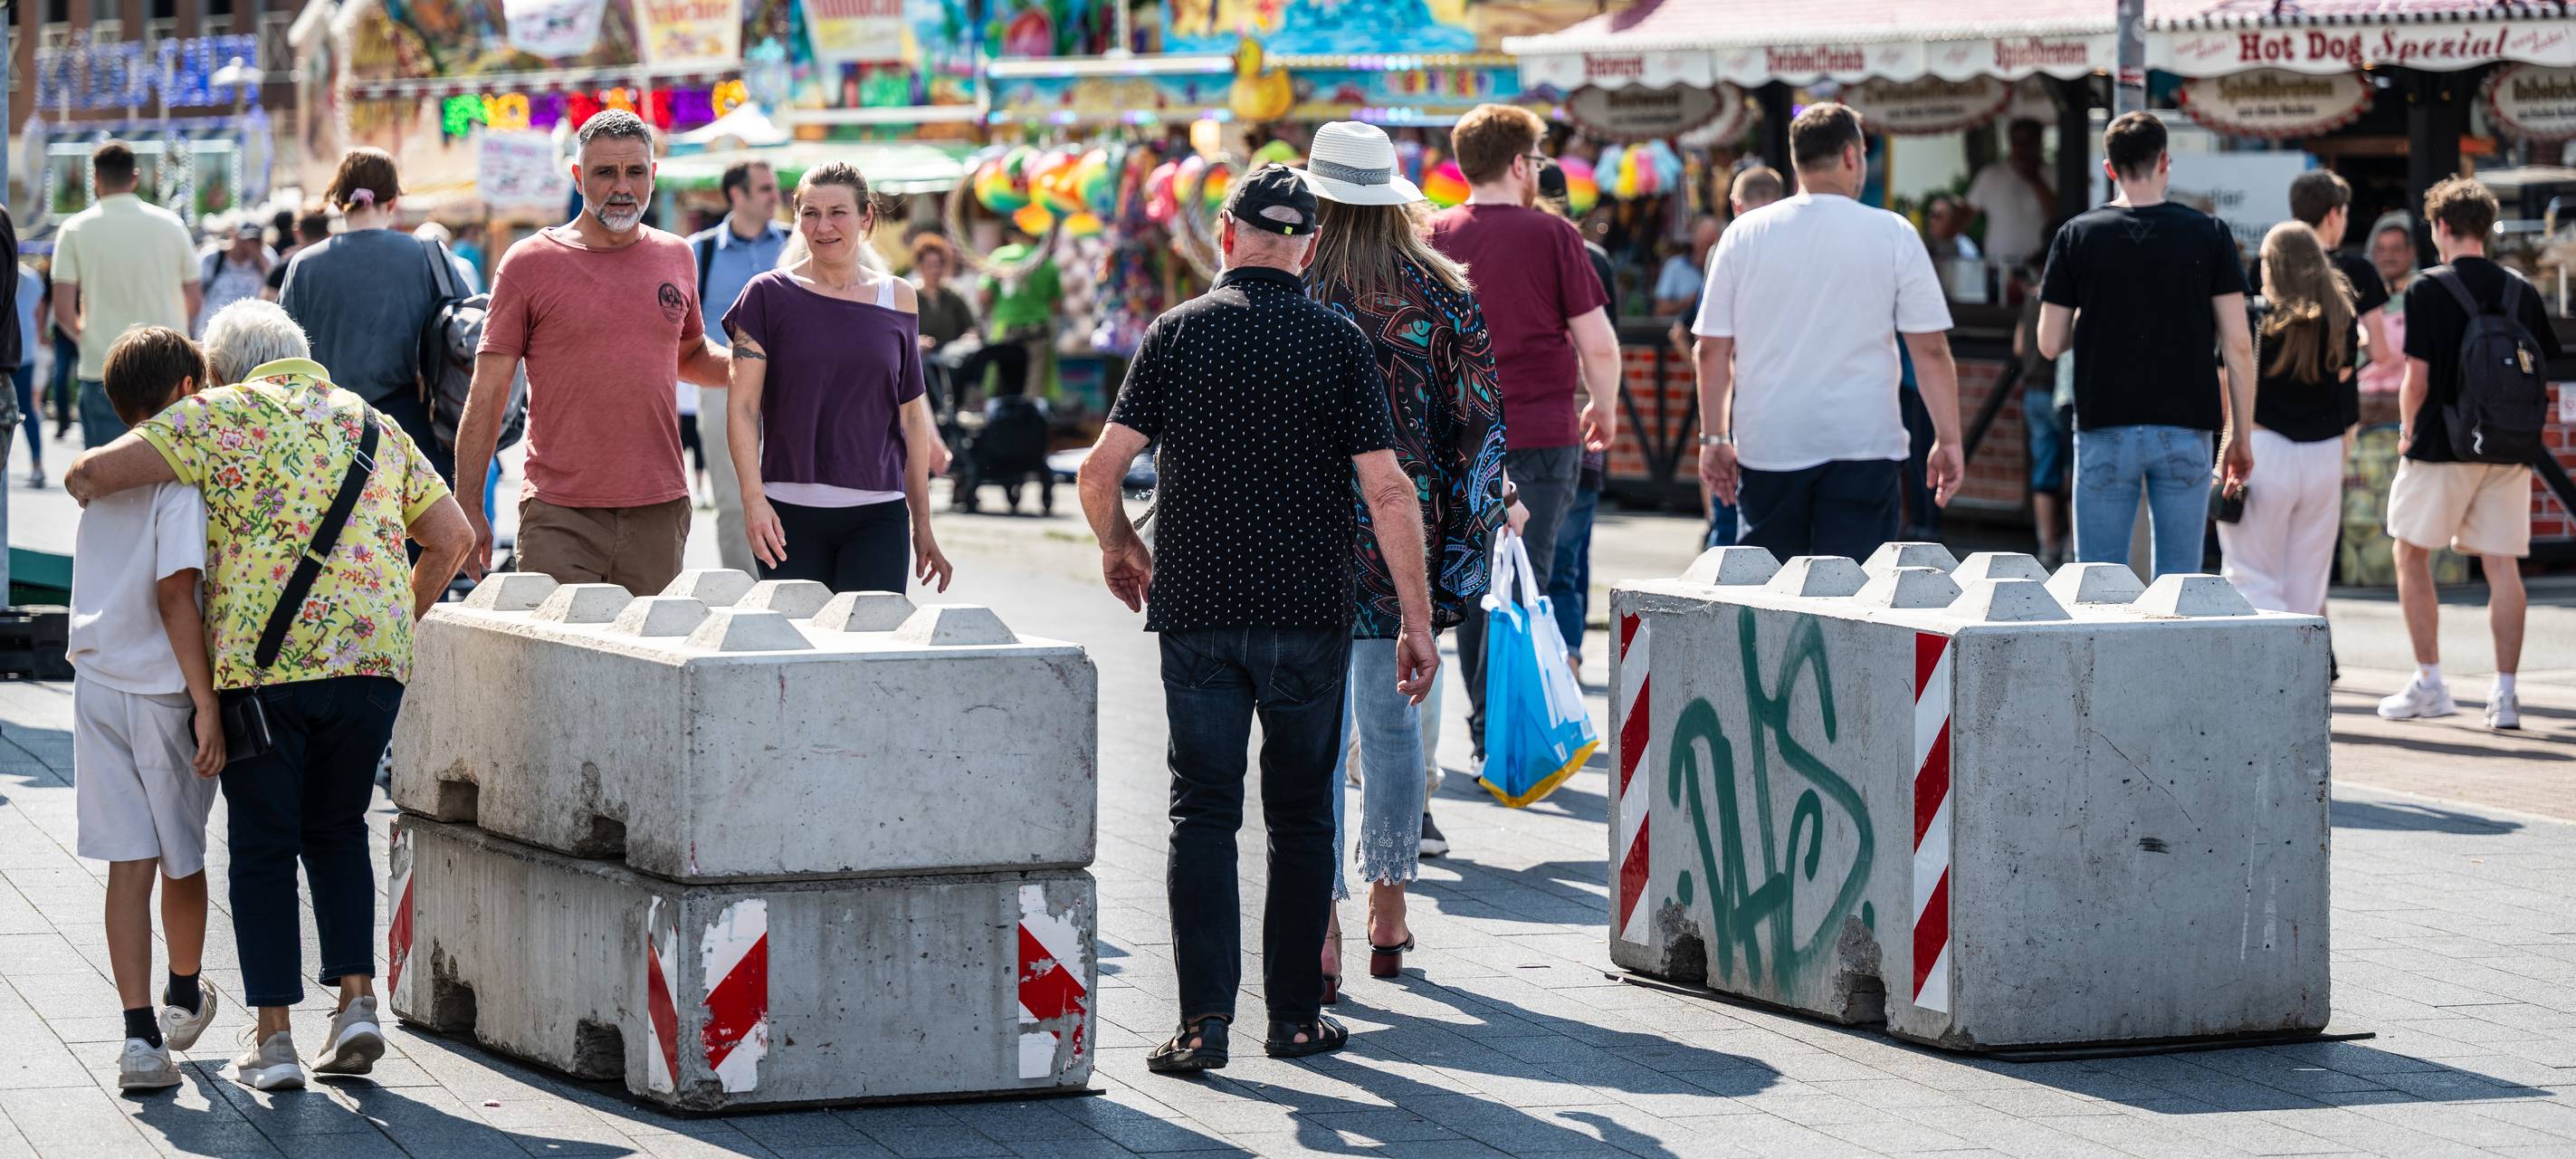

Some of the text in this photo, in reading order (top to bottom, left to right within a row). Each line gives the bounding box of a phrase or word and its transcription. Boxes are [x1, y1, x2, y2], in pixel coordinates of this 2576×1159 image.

[2238, 32, 2294, 62] Hot
[2307, 31, 2363, 69] Dog
[2371, 25, 2509, 64] Spezial
